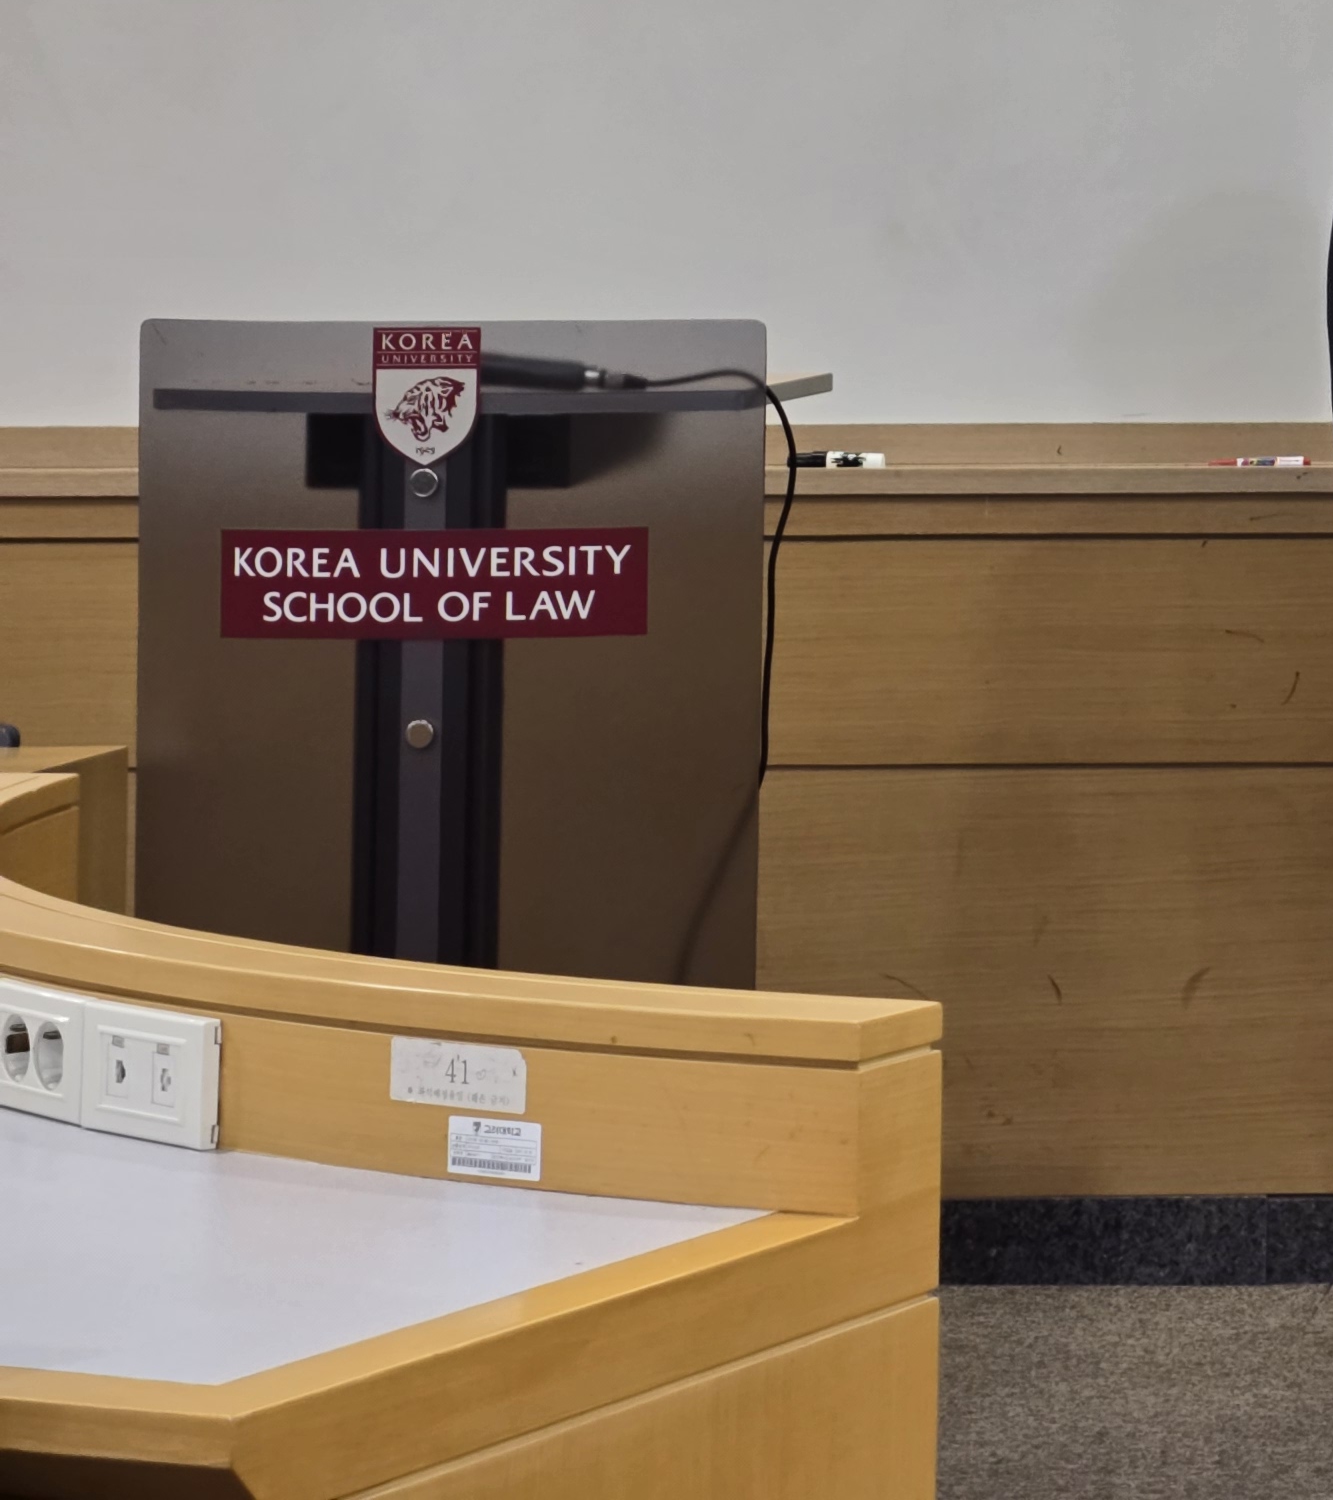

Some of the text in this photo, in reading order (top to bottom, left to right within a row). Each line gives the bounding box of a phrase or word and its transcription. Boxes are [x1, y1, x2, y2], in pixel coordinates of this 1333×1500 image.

[381, 333, 474, 350] KOREA
[381, 354, 474, 364] UNIVERSITY
[233, 543, 632, 580] KOREA UNIVERSITY
[262, 589, 596, 624] SCHOOL OF LAW
[444, 1057, 470, 1085] 41
